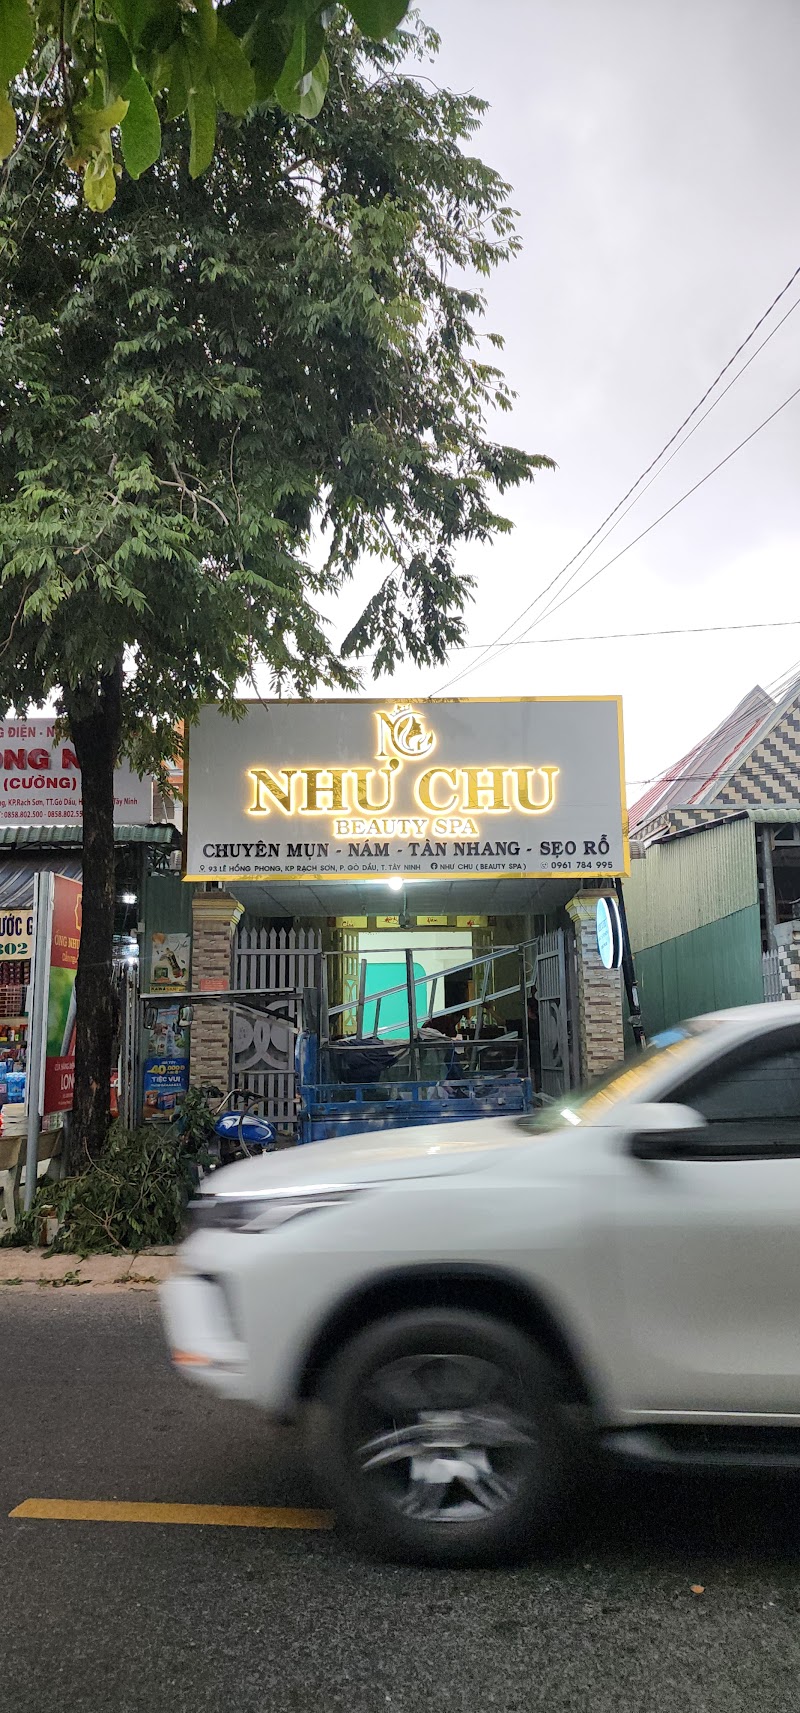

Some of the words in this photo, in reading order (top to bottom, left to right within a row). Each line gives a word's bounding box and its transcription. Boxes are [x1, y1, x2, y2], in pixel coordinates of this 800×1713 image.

[8, 724, 36, 741] ĐIỆN
[3, 774, 77, 791] (CƯỜNG)
[249, 758, 400, 812] NHƯ
[418, 767, 559, 811] CHU
[124, 797, 138, 805] Ninh
[336, 819, 428, 835] BEAUTY
[434, 819, 479, 835] SPA
[202, 840, 281, 858] CHUYÊN
[286, 843, 330, 860] MỤN
[348, 839, 390, 857] NÁM
[408, 838, 447, 857] TÀN
[453, 842, 520, 856] NHANG
[540, 841, 577, 858] SẸO
[583, 834, 610, 855] RỖ
[208, 865, 218, 873] 93
[254, 865, 283, 874] PHONG,
[296, 865, 318, 873] RẠCH
[347, 862, 360, 871] GÒ
[388, 863, 402, 871] TÂY
[440, 863, 456, 871] NHƯ
[457, 863, 474, 871] CHU
[551, 861, 572, 869] 0961
[576, 861, 592, 869] 784
[596, 861, 613, 869] 995
